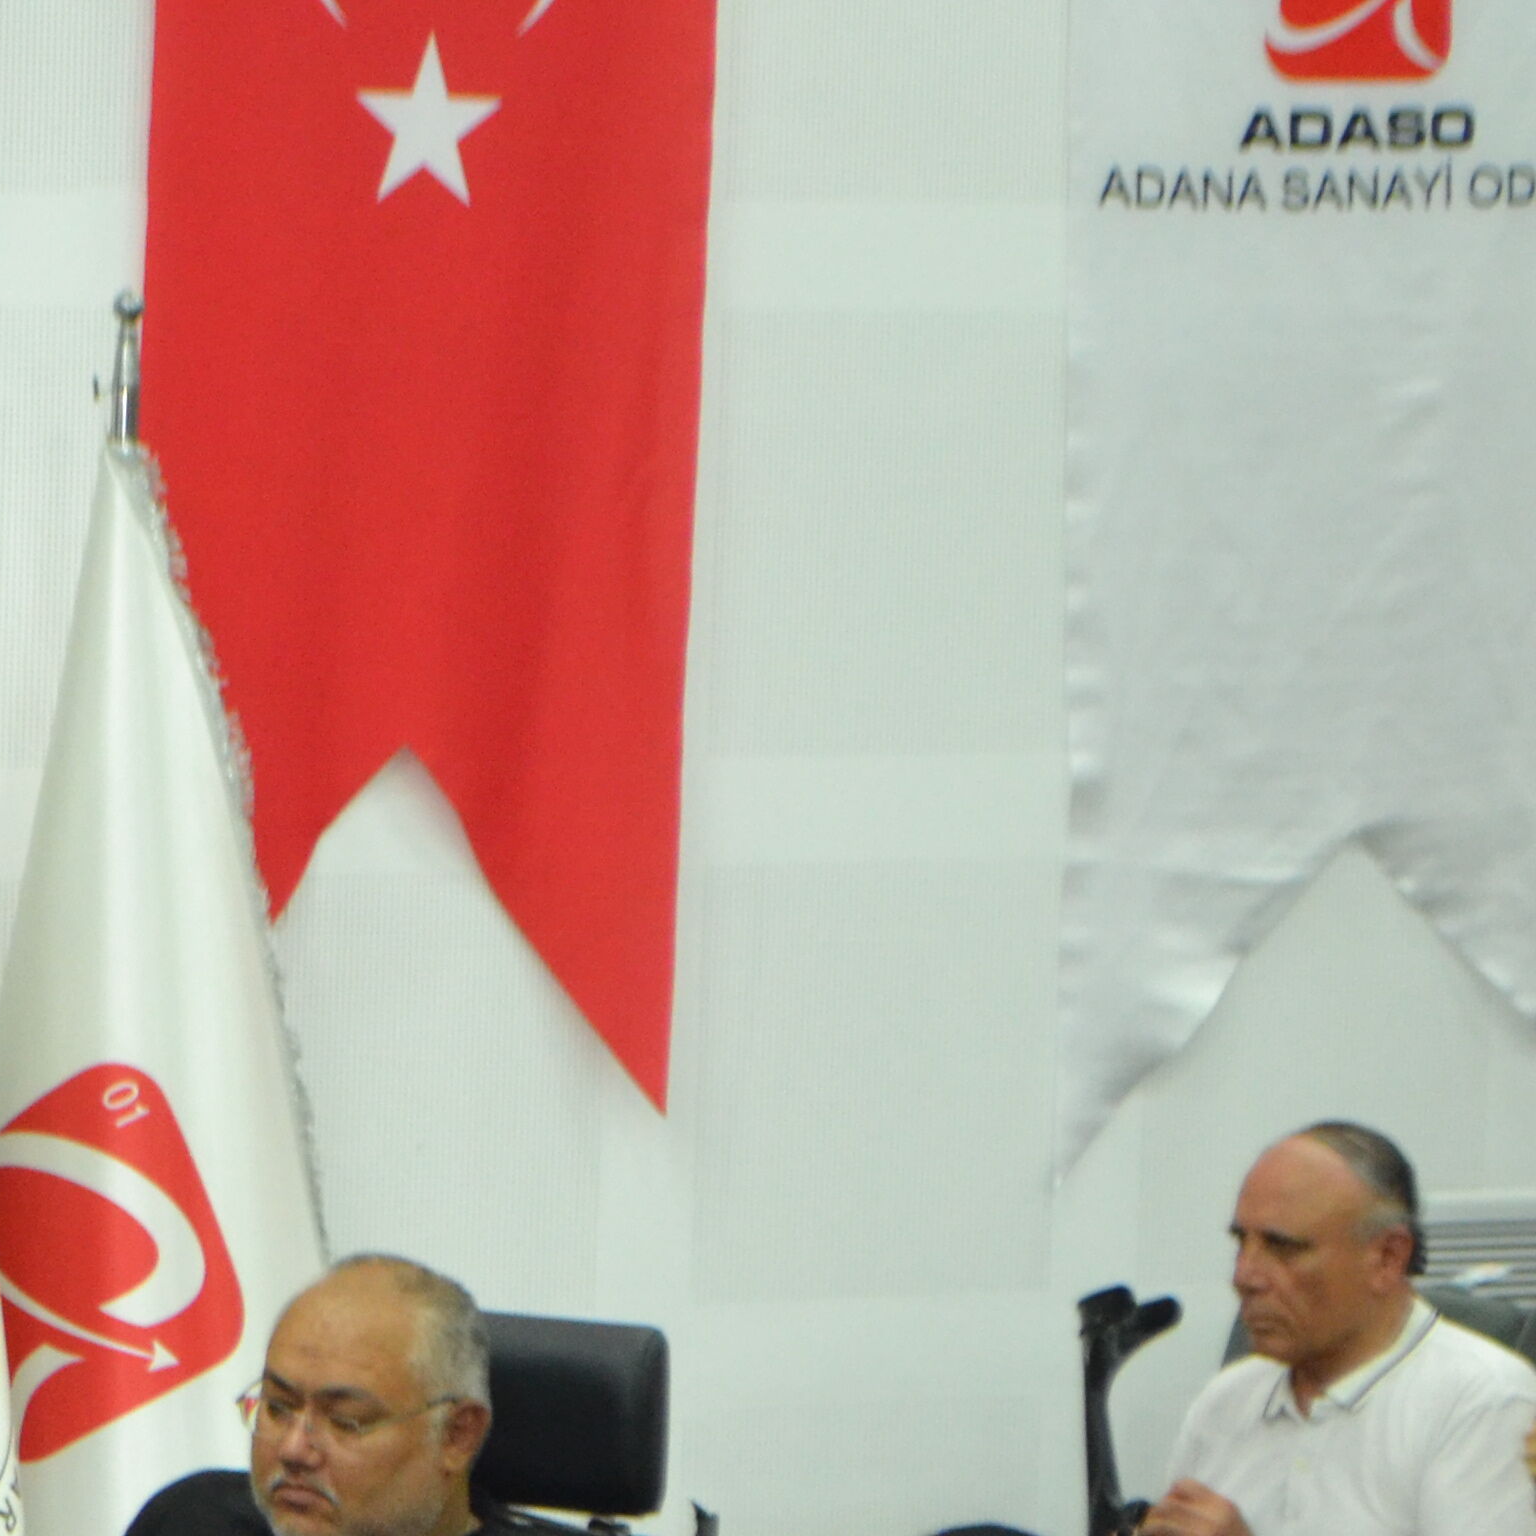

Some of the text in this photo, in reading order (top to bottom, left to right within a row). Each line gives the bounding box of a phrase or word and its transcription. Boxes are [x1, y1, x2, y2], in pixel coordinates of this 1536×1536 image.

[1239, 106, 1476, 153] ADASO
[1098, 163, 1268, 211] ADANA
[1281, 155, 1454, 211] SANAYİ
[101, 1078, 151, 1129] 01
